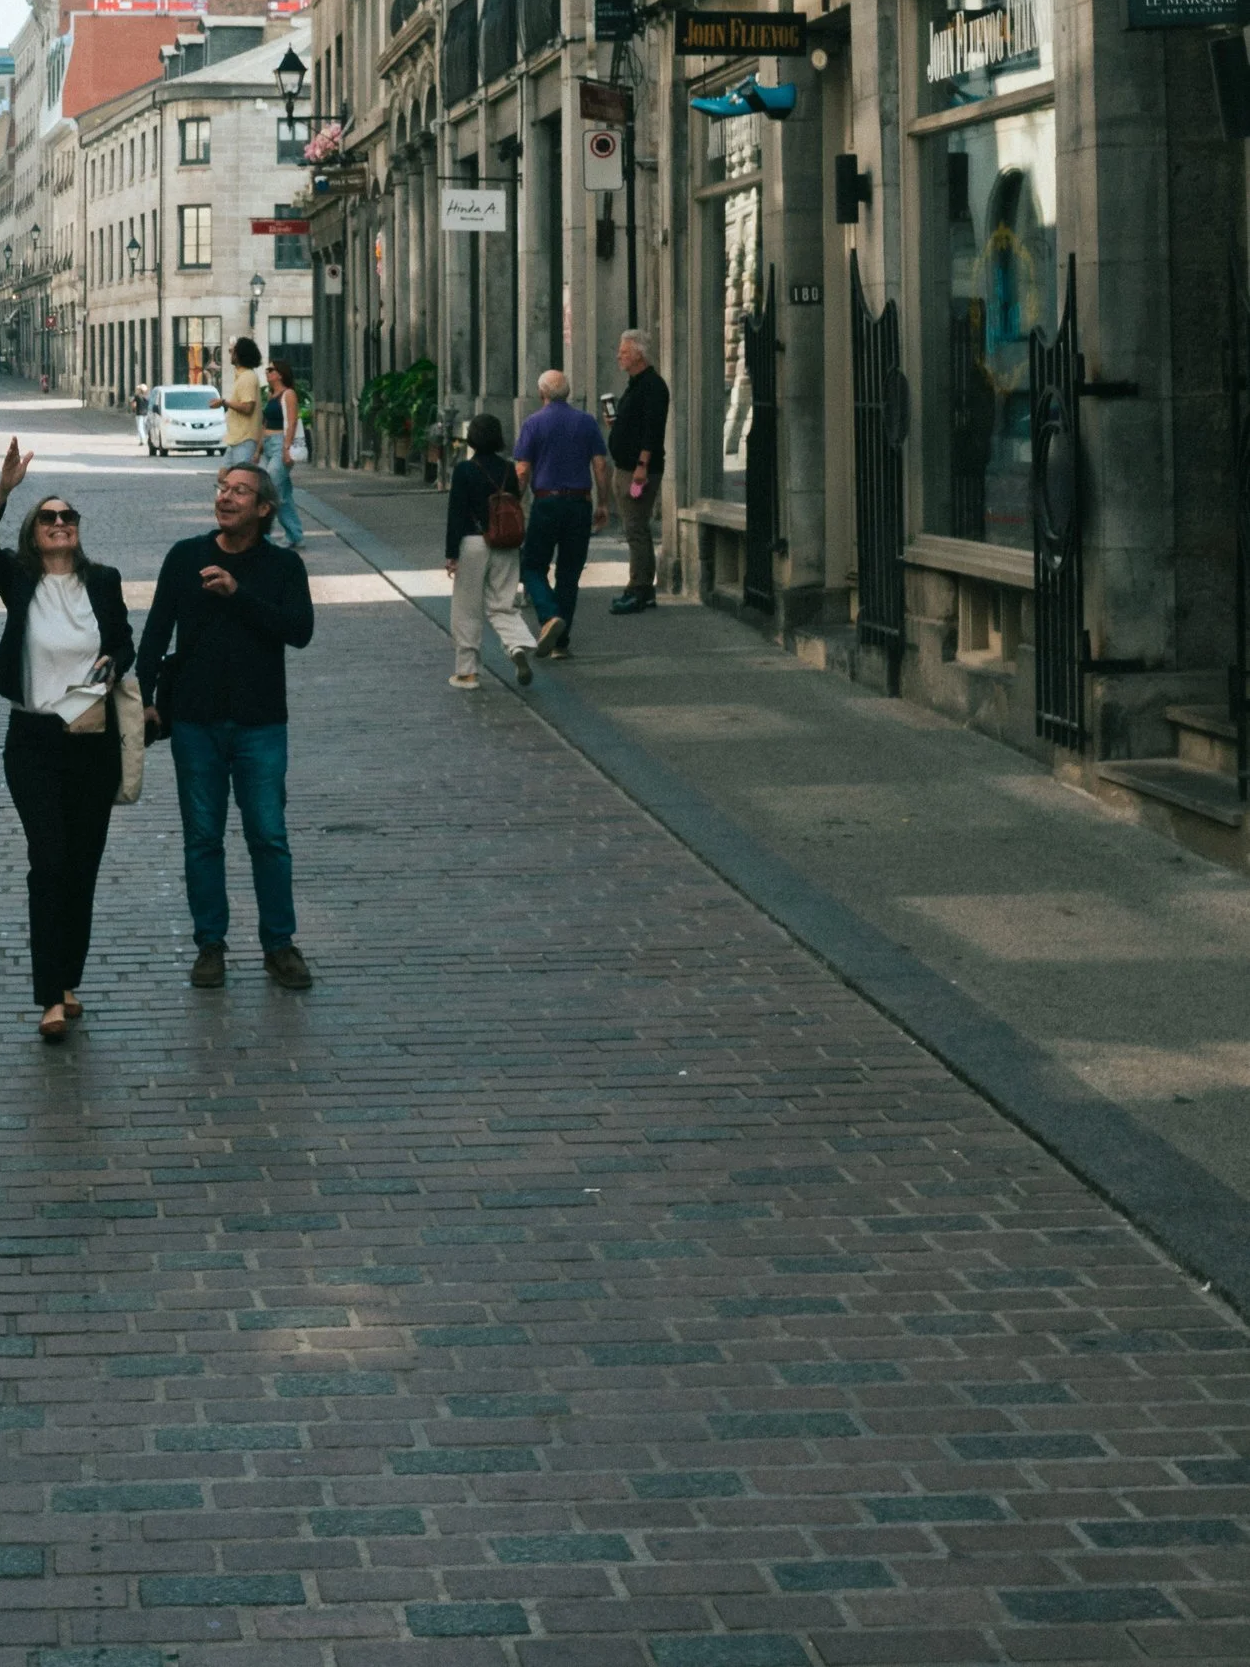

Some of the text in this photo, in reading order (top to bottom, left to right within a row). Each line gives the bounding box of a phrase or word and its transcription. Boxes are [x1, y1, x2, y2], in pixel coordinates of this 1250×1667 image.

[683, 17, 800, 47] JOHN FLUEVOG
[447, 199, 481, 216] Hinda
[794, 287, 819, 302] 180
